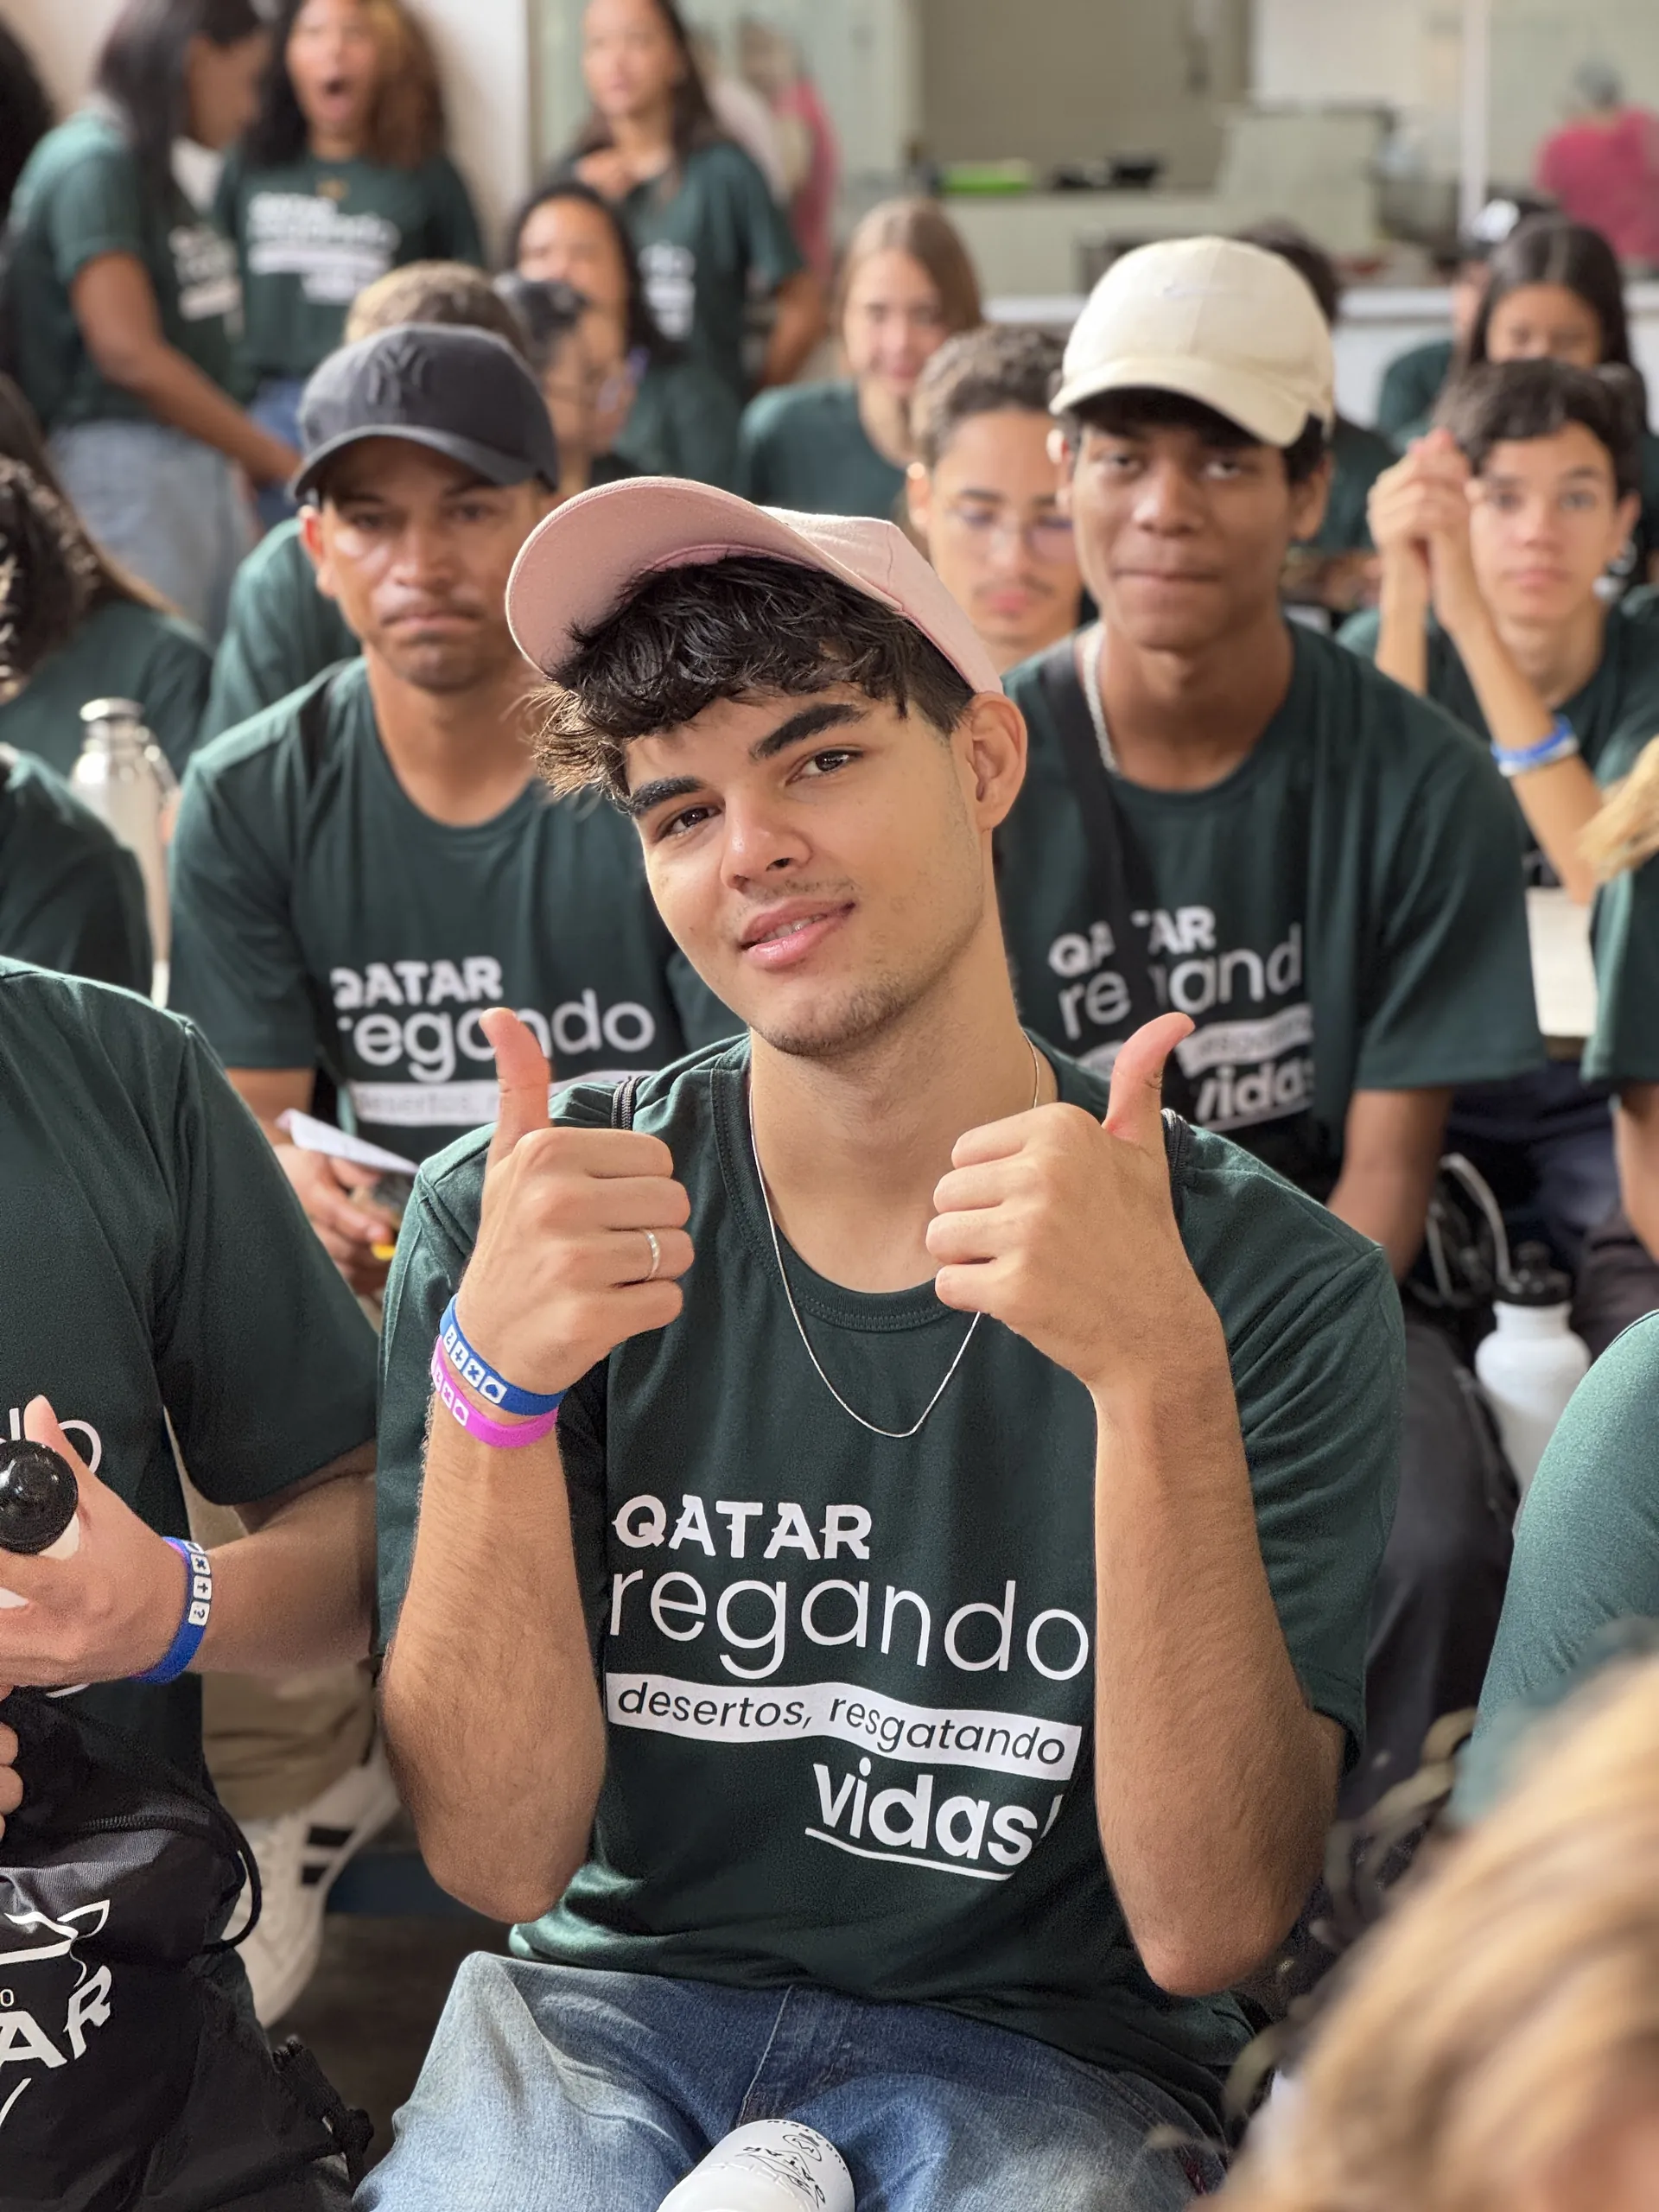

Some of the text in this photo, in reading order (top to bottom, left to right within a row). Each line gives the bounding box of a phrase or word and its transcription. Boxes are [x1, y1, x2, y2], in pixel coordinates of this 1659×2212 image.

[337, 988, 656, 1083] egando
[612, 1494, 873, 1560] QATAR
[609, 1570, 1090, 1681] regando
[618, 1681, 1065, 1765] desertos, resgatando
